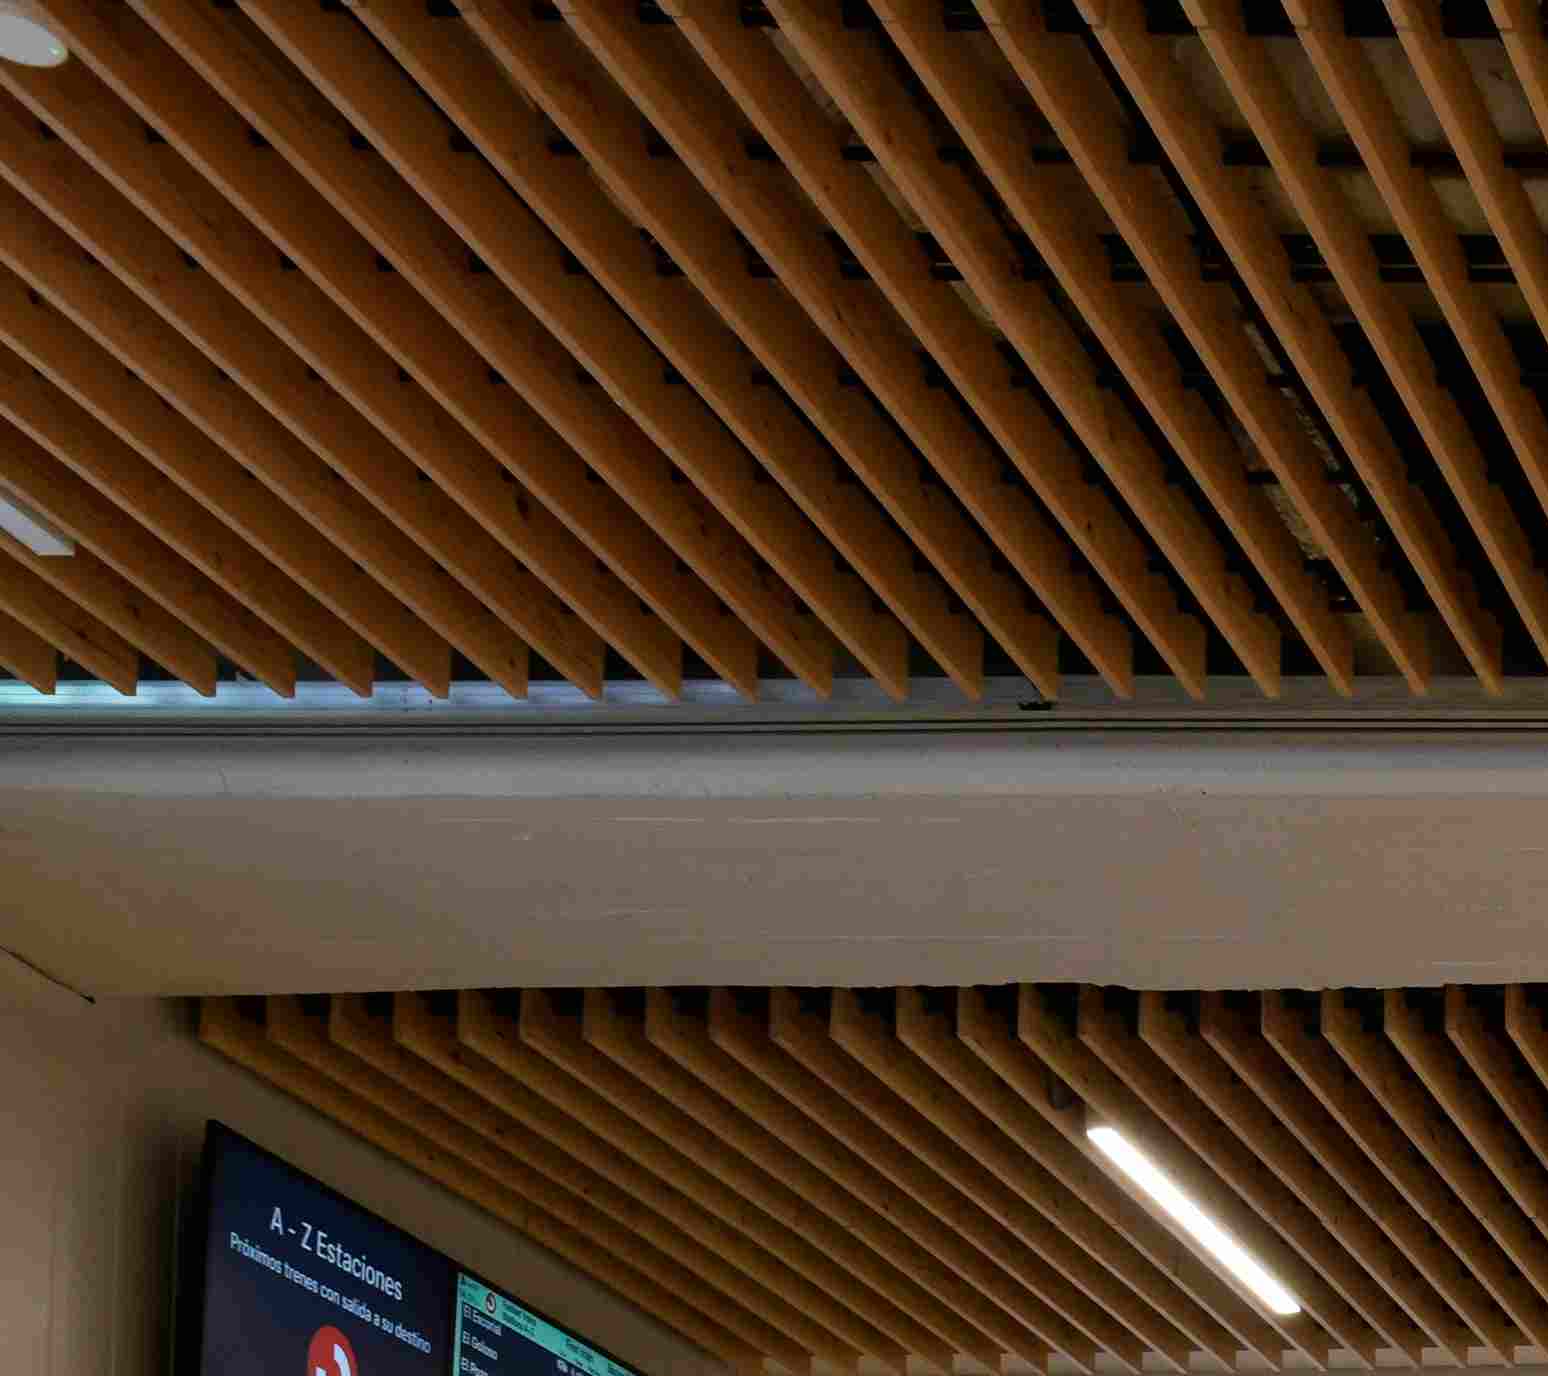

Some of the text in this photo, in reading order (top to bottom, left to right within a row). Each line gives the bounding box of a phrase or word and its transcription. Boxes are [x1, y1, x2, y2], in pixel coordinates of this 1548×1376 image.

[229, 1230, 432, 1355] Próximos trenes con salida a su destino
[269, 1202, 285, 1237] A
[299, 1219, 313, 1252] Z
[315, 1228, 403, 1302] Estaciones
